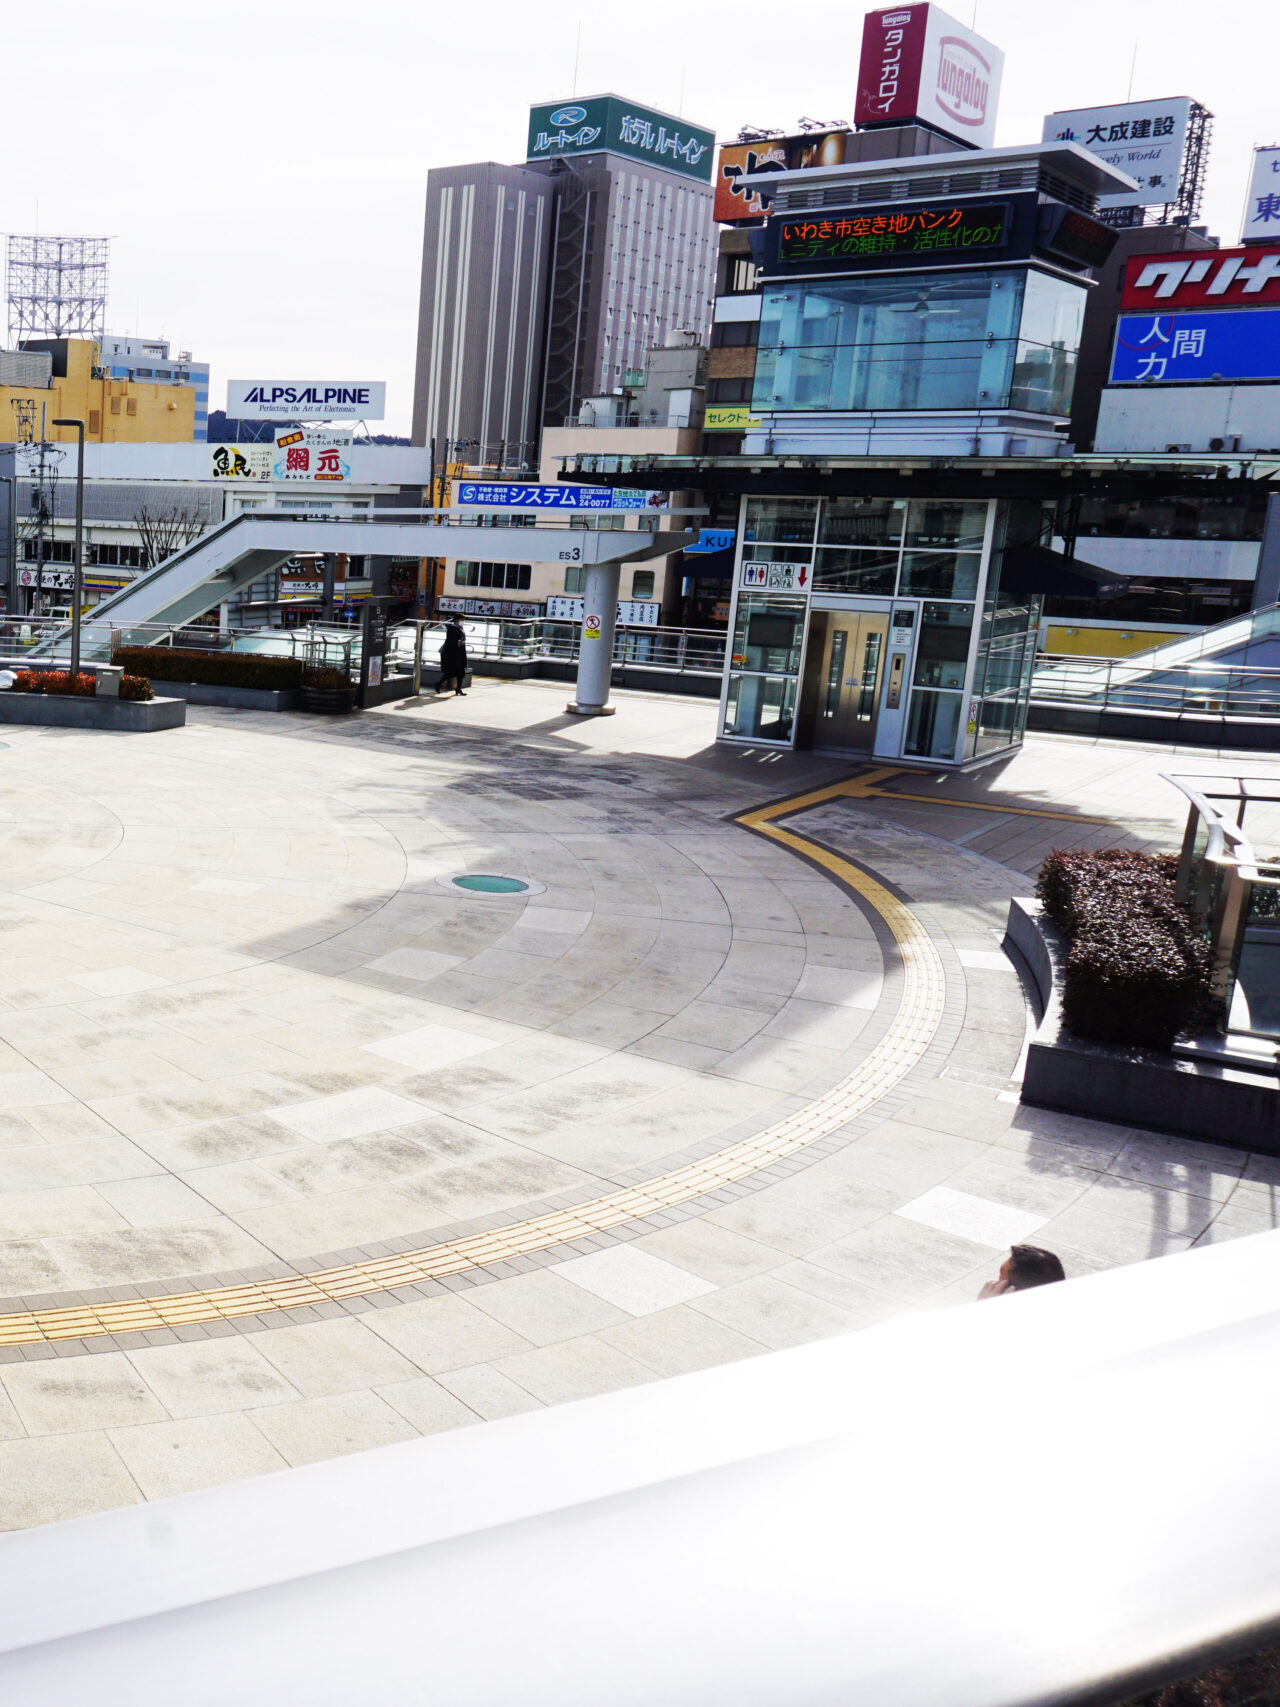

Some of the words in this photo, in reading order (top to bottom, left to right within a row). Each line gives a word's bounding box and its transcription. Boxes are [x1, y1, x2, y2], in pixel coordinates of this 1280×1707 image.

[881, 14, 911, 25] Tungaloy
[878, 29, 903, 113] タンガロイ
[937, 44, 989, 112] Tungaloy
[533, 126, 601, 151] ルートイン
[620, 115, 656, 150] ホテル
[655, 126, 708, 165] ルートイン
[1085, 116, 1176, 145] 大成建設
[1128, 149, 1162, 162] World
[783, 208, 963, 241] いわき市空き地バンク
[259, 404, 291, 413] Perfecting
[291, 404, 301, 412] the
[302, 404, 313, 412] Art
[314, 404, 322, 412] of
[323, 404, 356, 413] Electronics
[286, 448, 341, 472] 網元
[477, 493, 507, 503] 株式会社
[510, 487, 577, 506] システム
